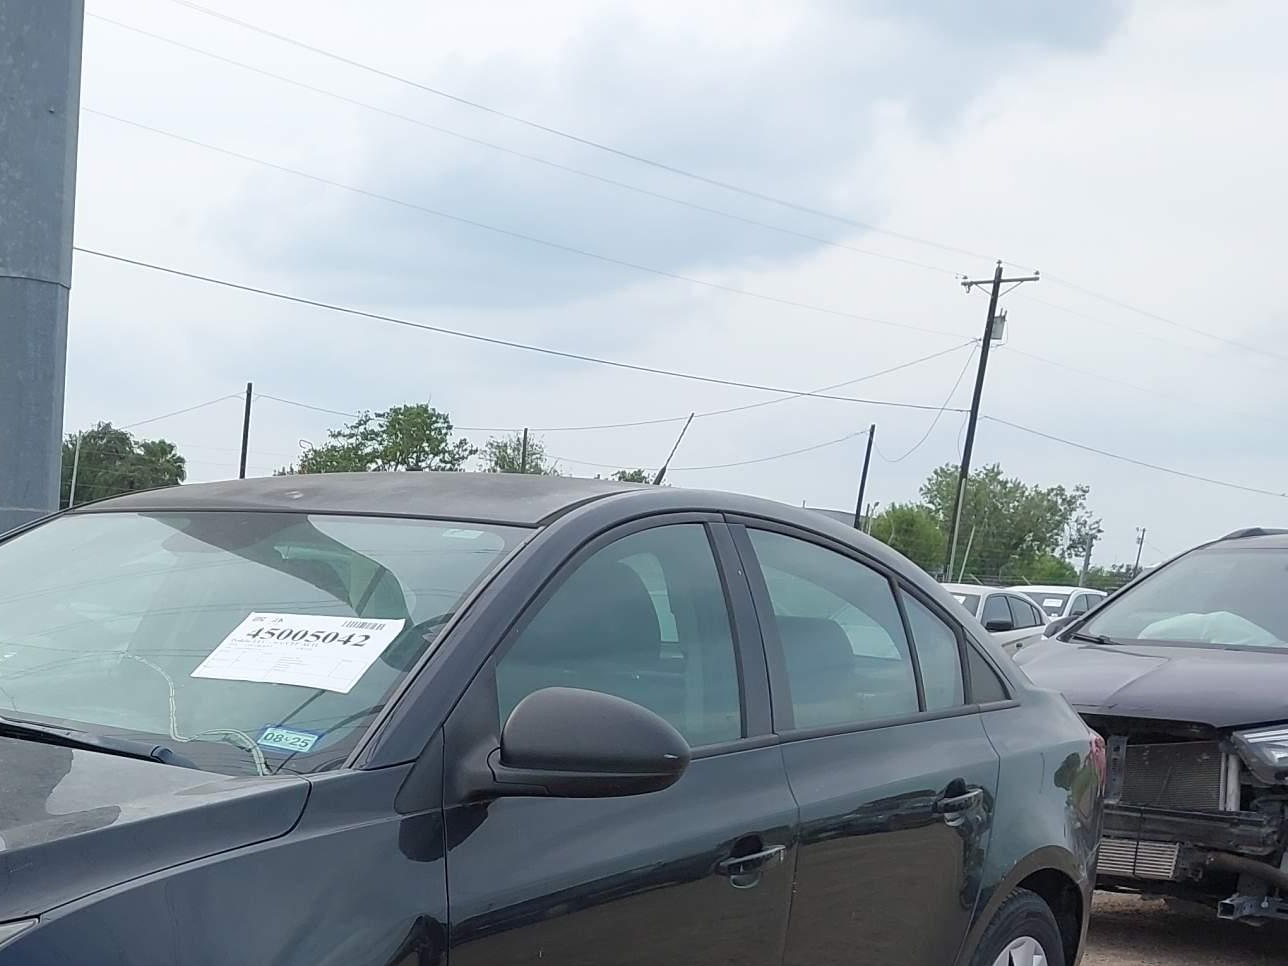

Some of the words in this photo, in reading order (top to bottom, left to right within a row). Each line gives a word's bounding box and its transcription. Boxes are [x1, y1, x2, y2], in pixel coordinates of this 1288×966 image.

[246, 626, 371, 648] 45005042
[263, 732, 285, 743] 08
[289, 736, 313, 748] 25
